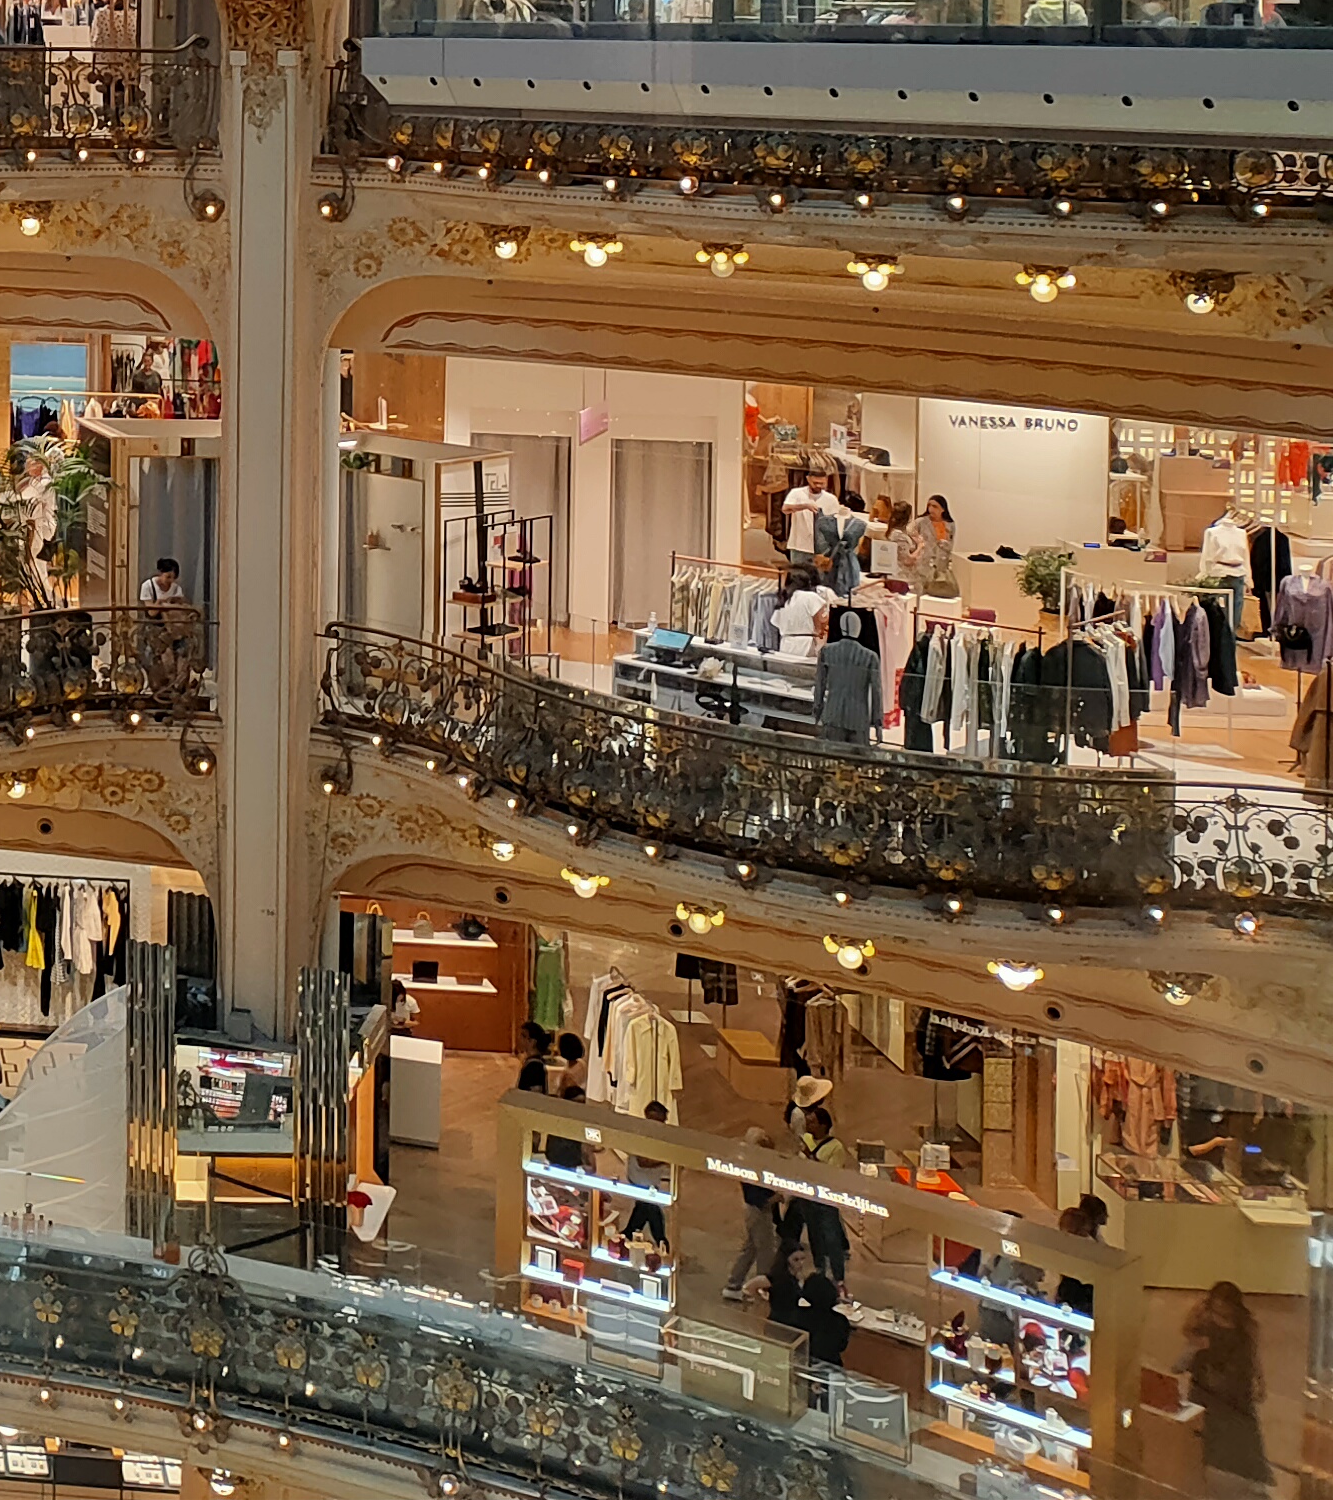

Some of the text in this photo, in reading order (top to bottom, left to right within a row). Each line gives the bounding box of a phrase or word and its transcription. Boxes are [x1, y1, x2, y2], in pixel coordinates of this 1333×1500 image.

[948, 414, 1079, 432] VANESSA BRUNO
[706, 1157, 890, 1218] Maison Francis Kurkdjian
